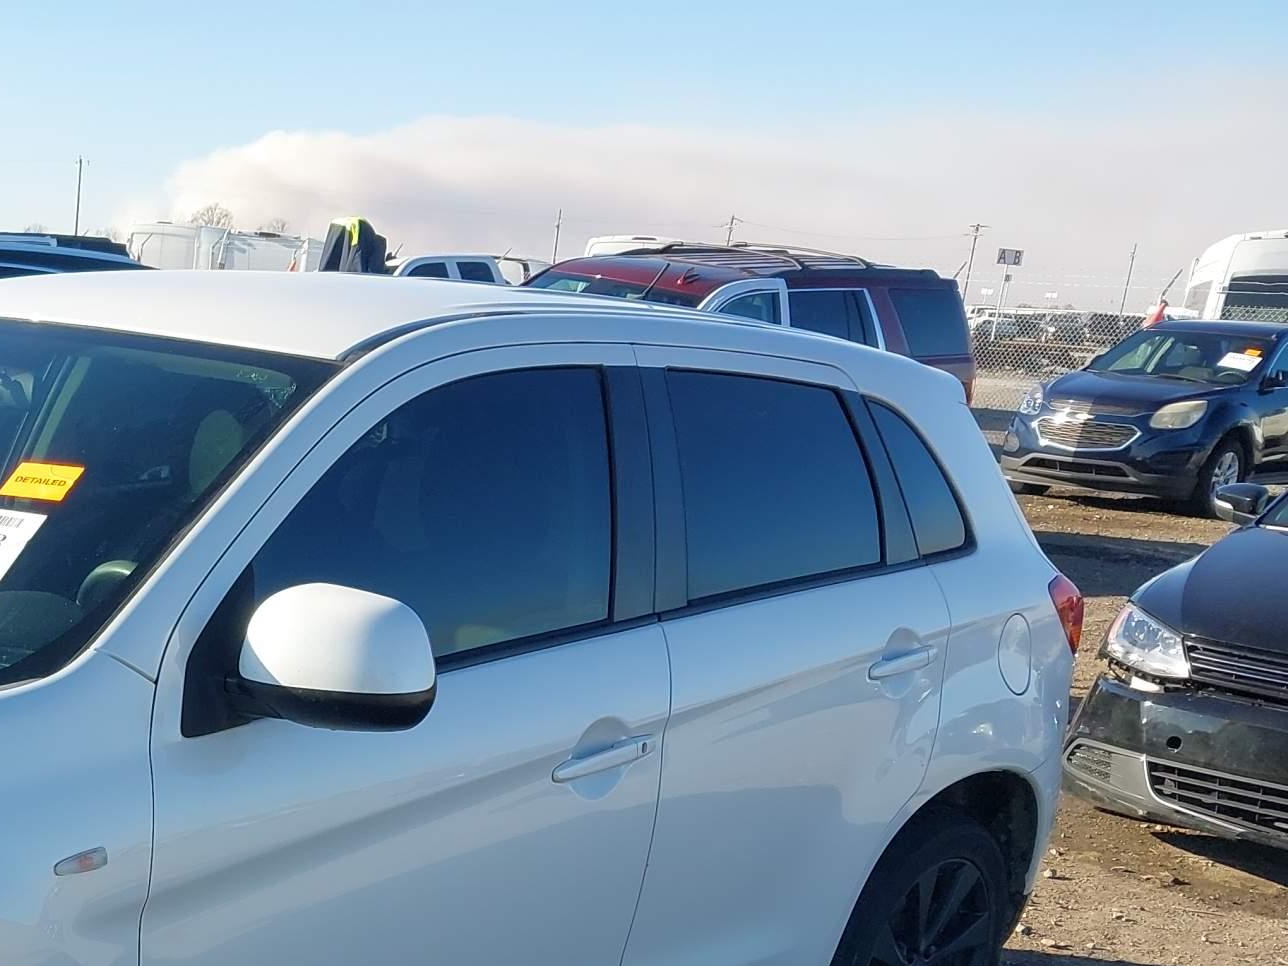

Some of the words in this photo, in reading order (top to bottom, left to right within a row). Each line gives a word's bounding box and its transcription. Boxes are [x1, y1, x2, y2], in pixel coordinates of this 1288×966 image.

[997, 249, 1006, 264] A
[1013, 250, 1021, 265] B
[15, 475, 67, 487] DETAILED
